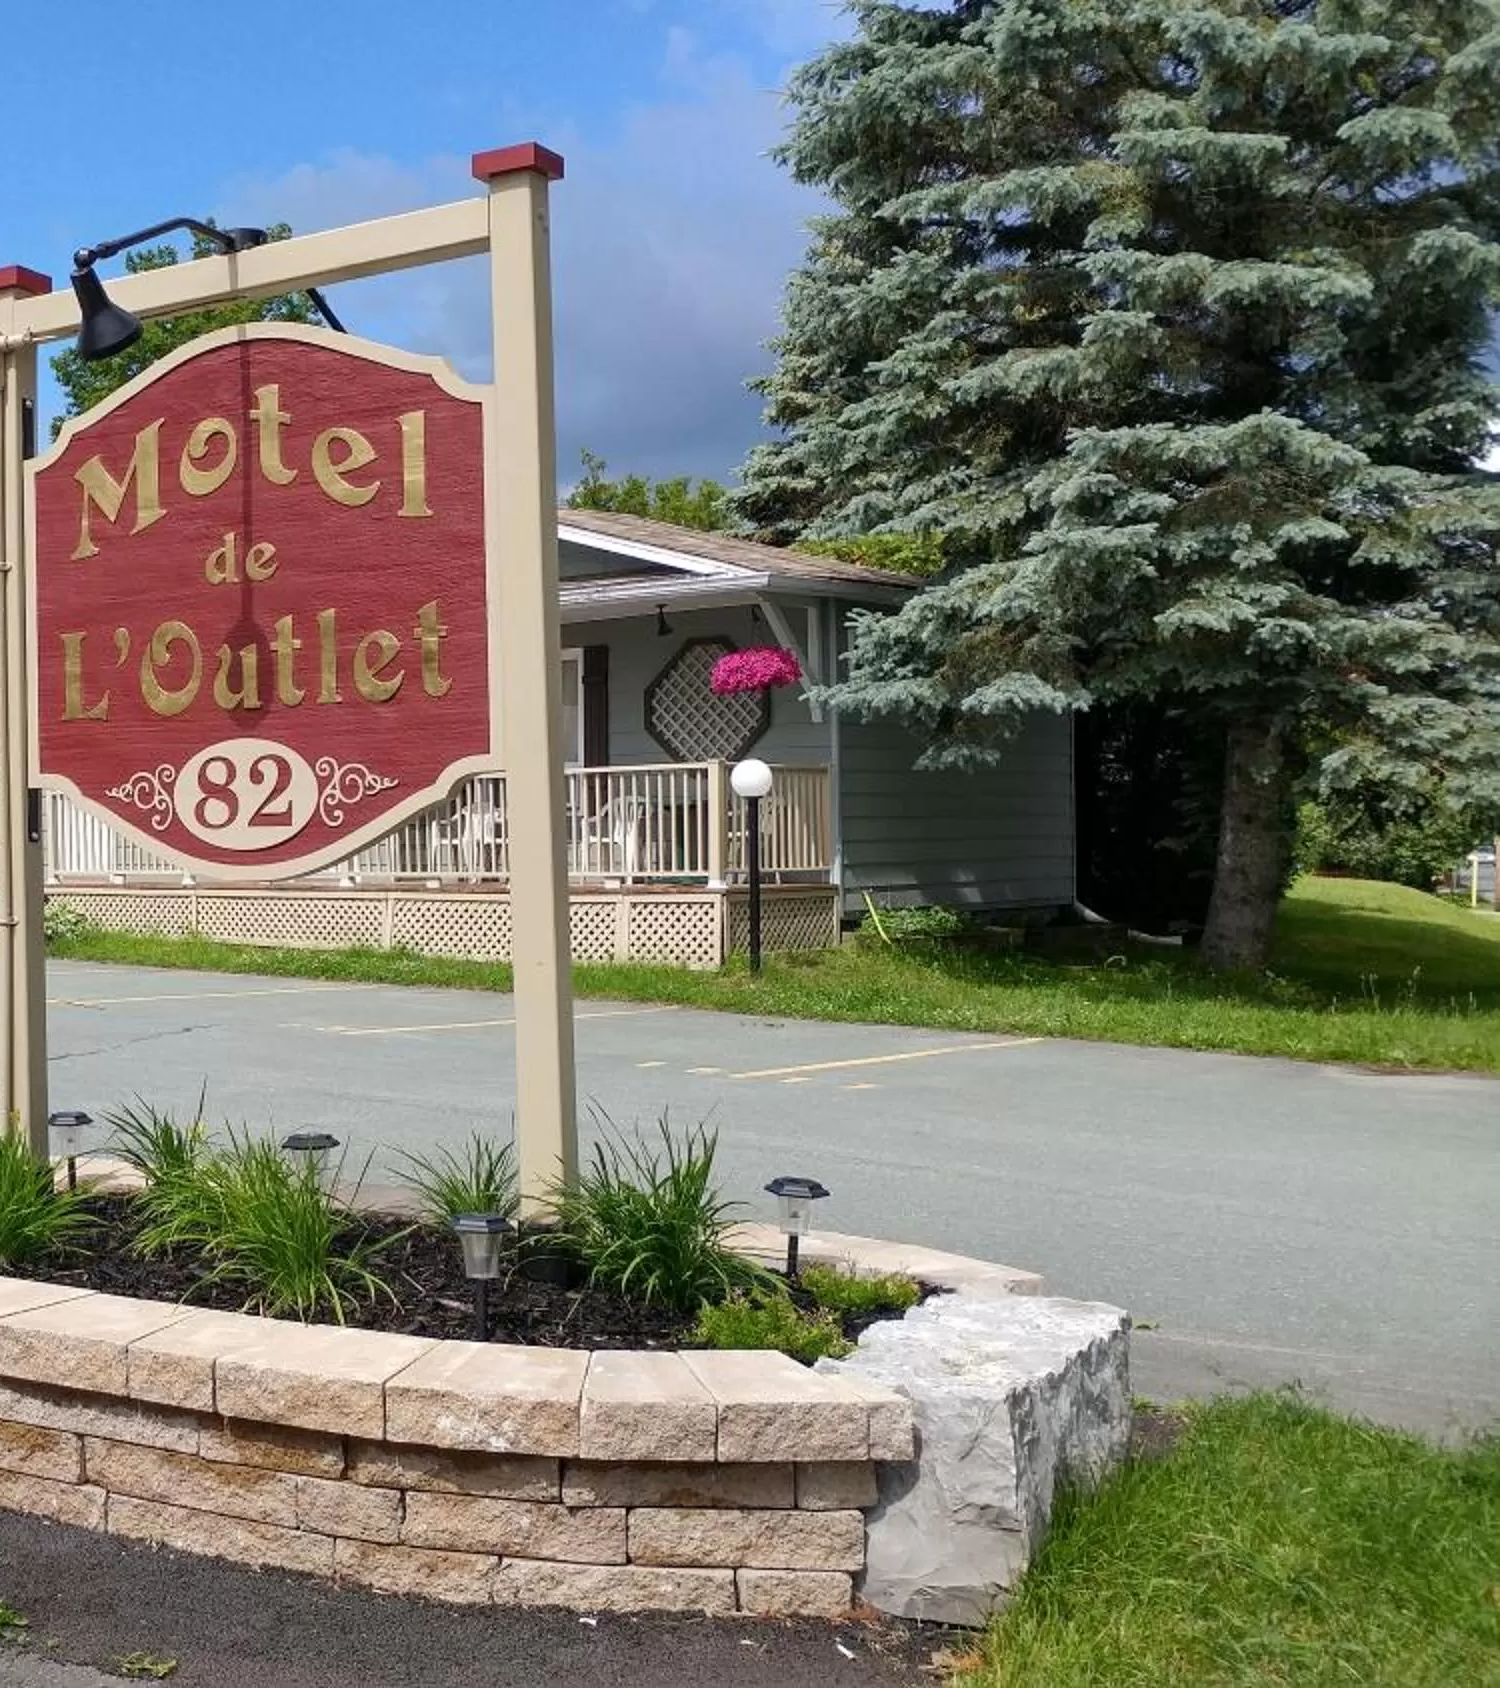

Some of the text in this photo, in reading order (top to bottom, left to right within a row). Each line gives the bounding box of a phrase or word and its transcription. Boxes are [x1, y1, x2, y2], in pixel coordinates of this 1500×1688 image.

[69, 383, 434, 561] Motel
[204, 531, 279, 586] de
[59, 598, 454, 722] L'Outlet
[193, 752, 295, 829] 82
